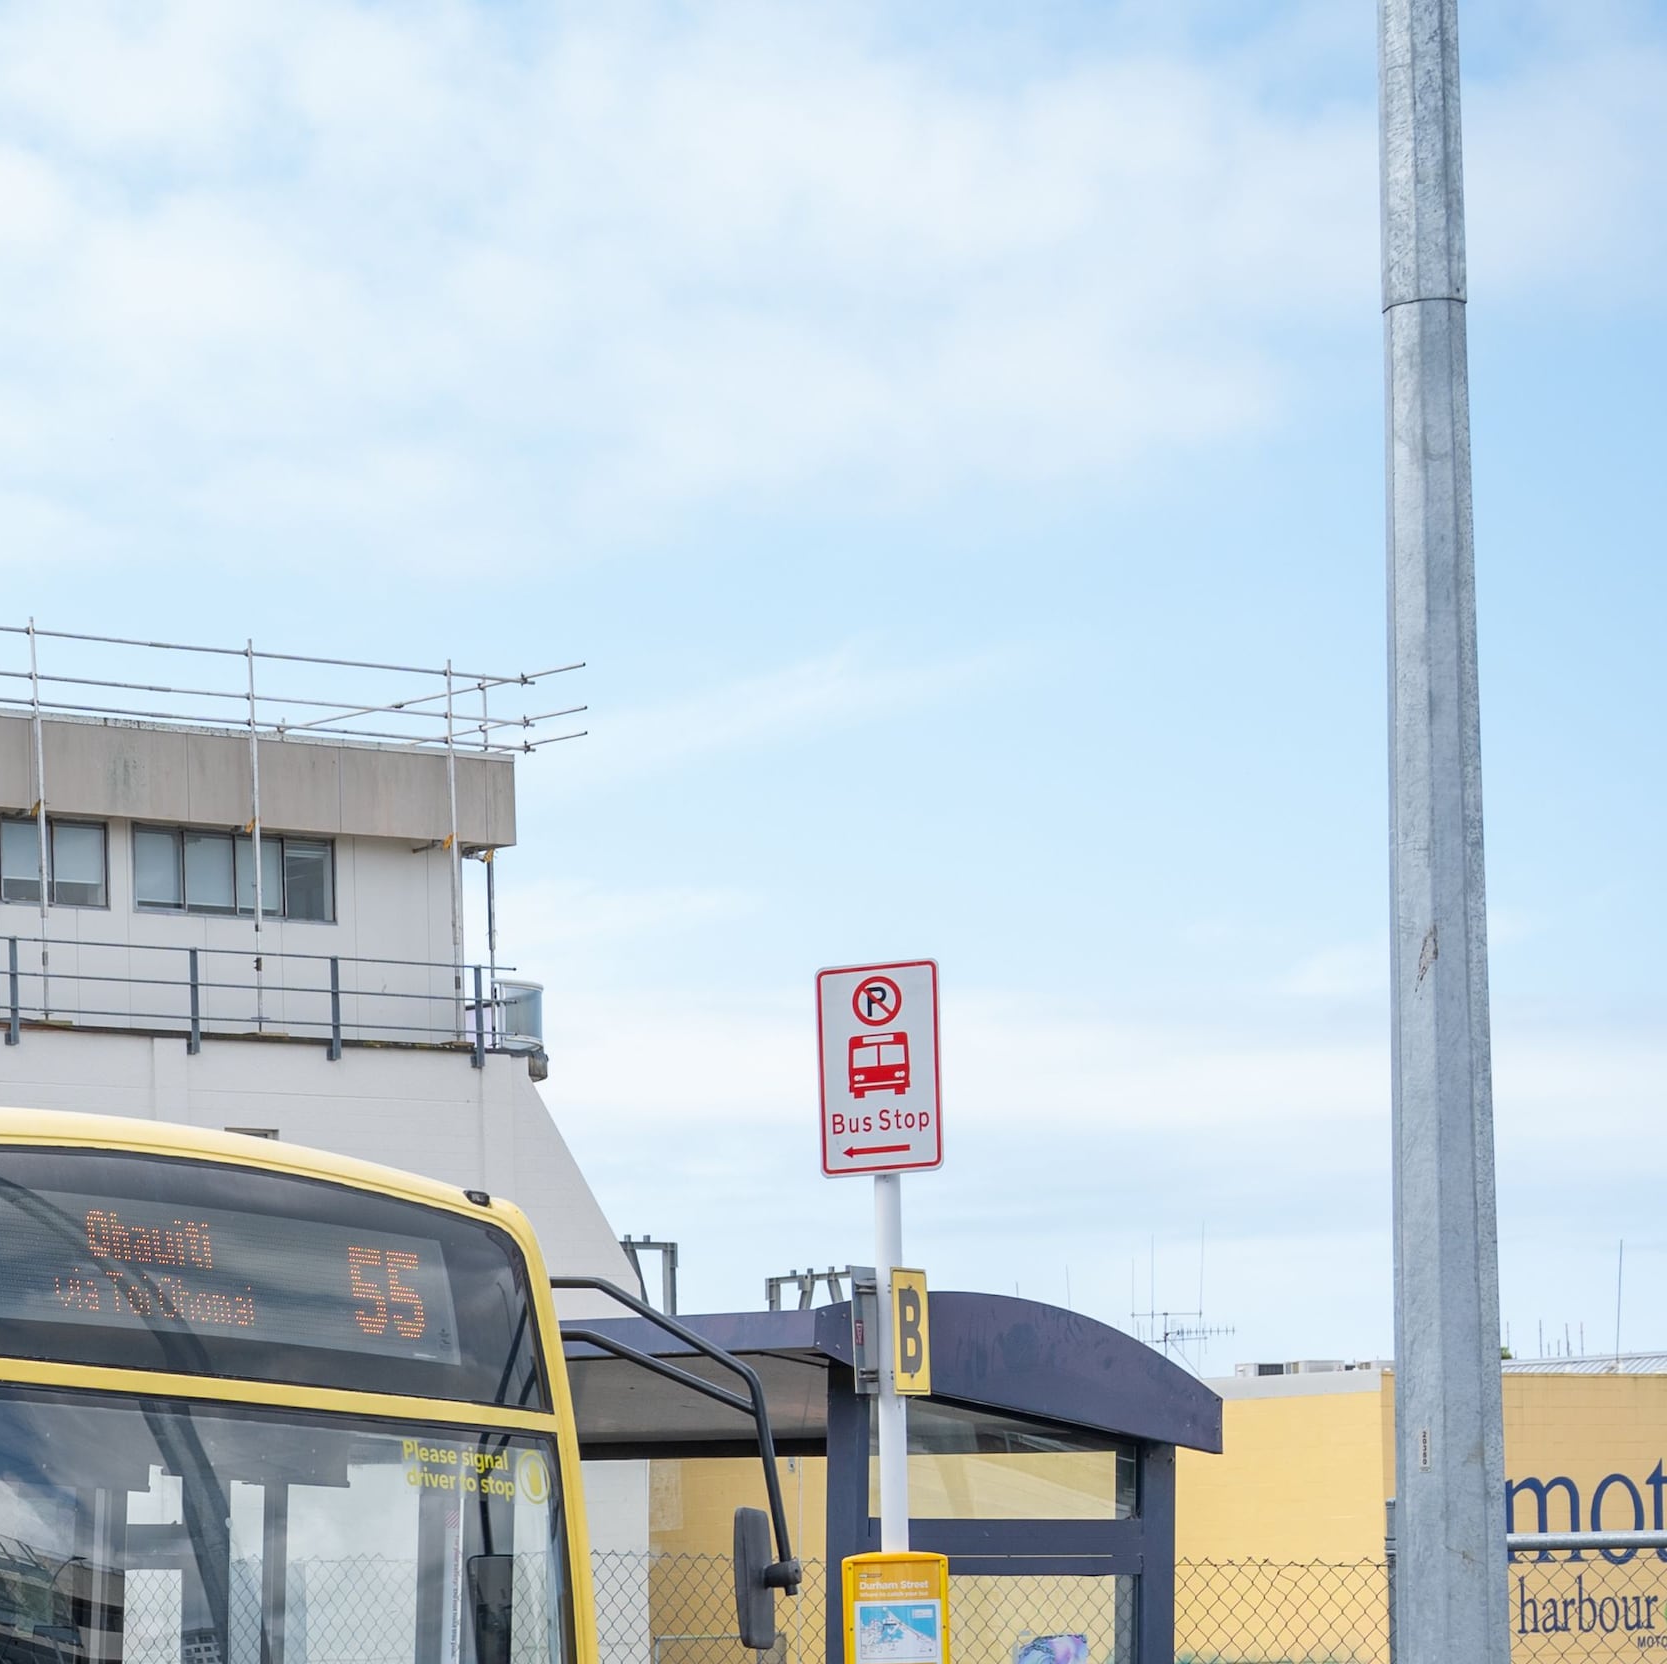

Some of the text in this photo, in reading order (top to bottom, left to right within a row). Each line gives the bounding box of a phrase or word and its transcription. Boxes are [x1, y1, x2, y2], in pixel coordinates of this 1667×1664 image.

[832, 1108, 930, 1135] Bus Stop
[54, 1268, 100, 1311] via
[347, 1246, 426, 1339] 55
[898, 1288, 923, 1374] B
[402, 1439, 510, 1474] Please signal
[406, 1463, 515, 1502] driver to stop
[859, 1580, 928, 1590] Durham Street
[1518, 1573, 1658, 1634] harbour
